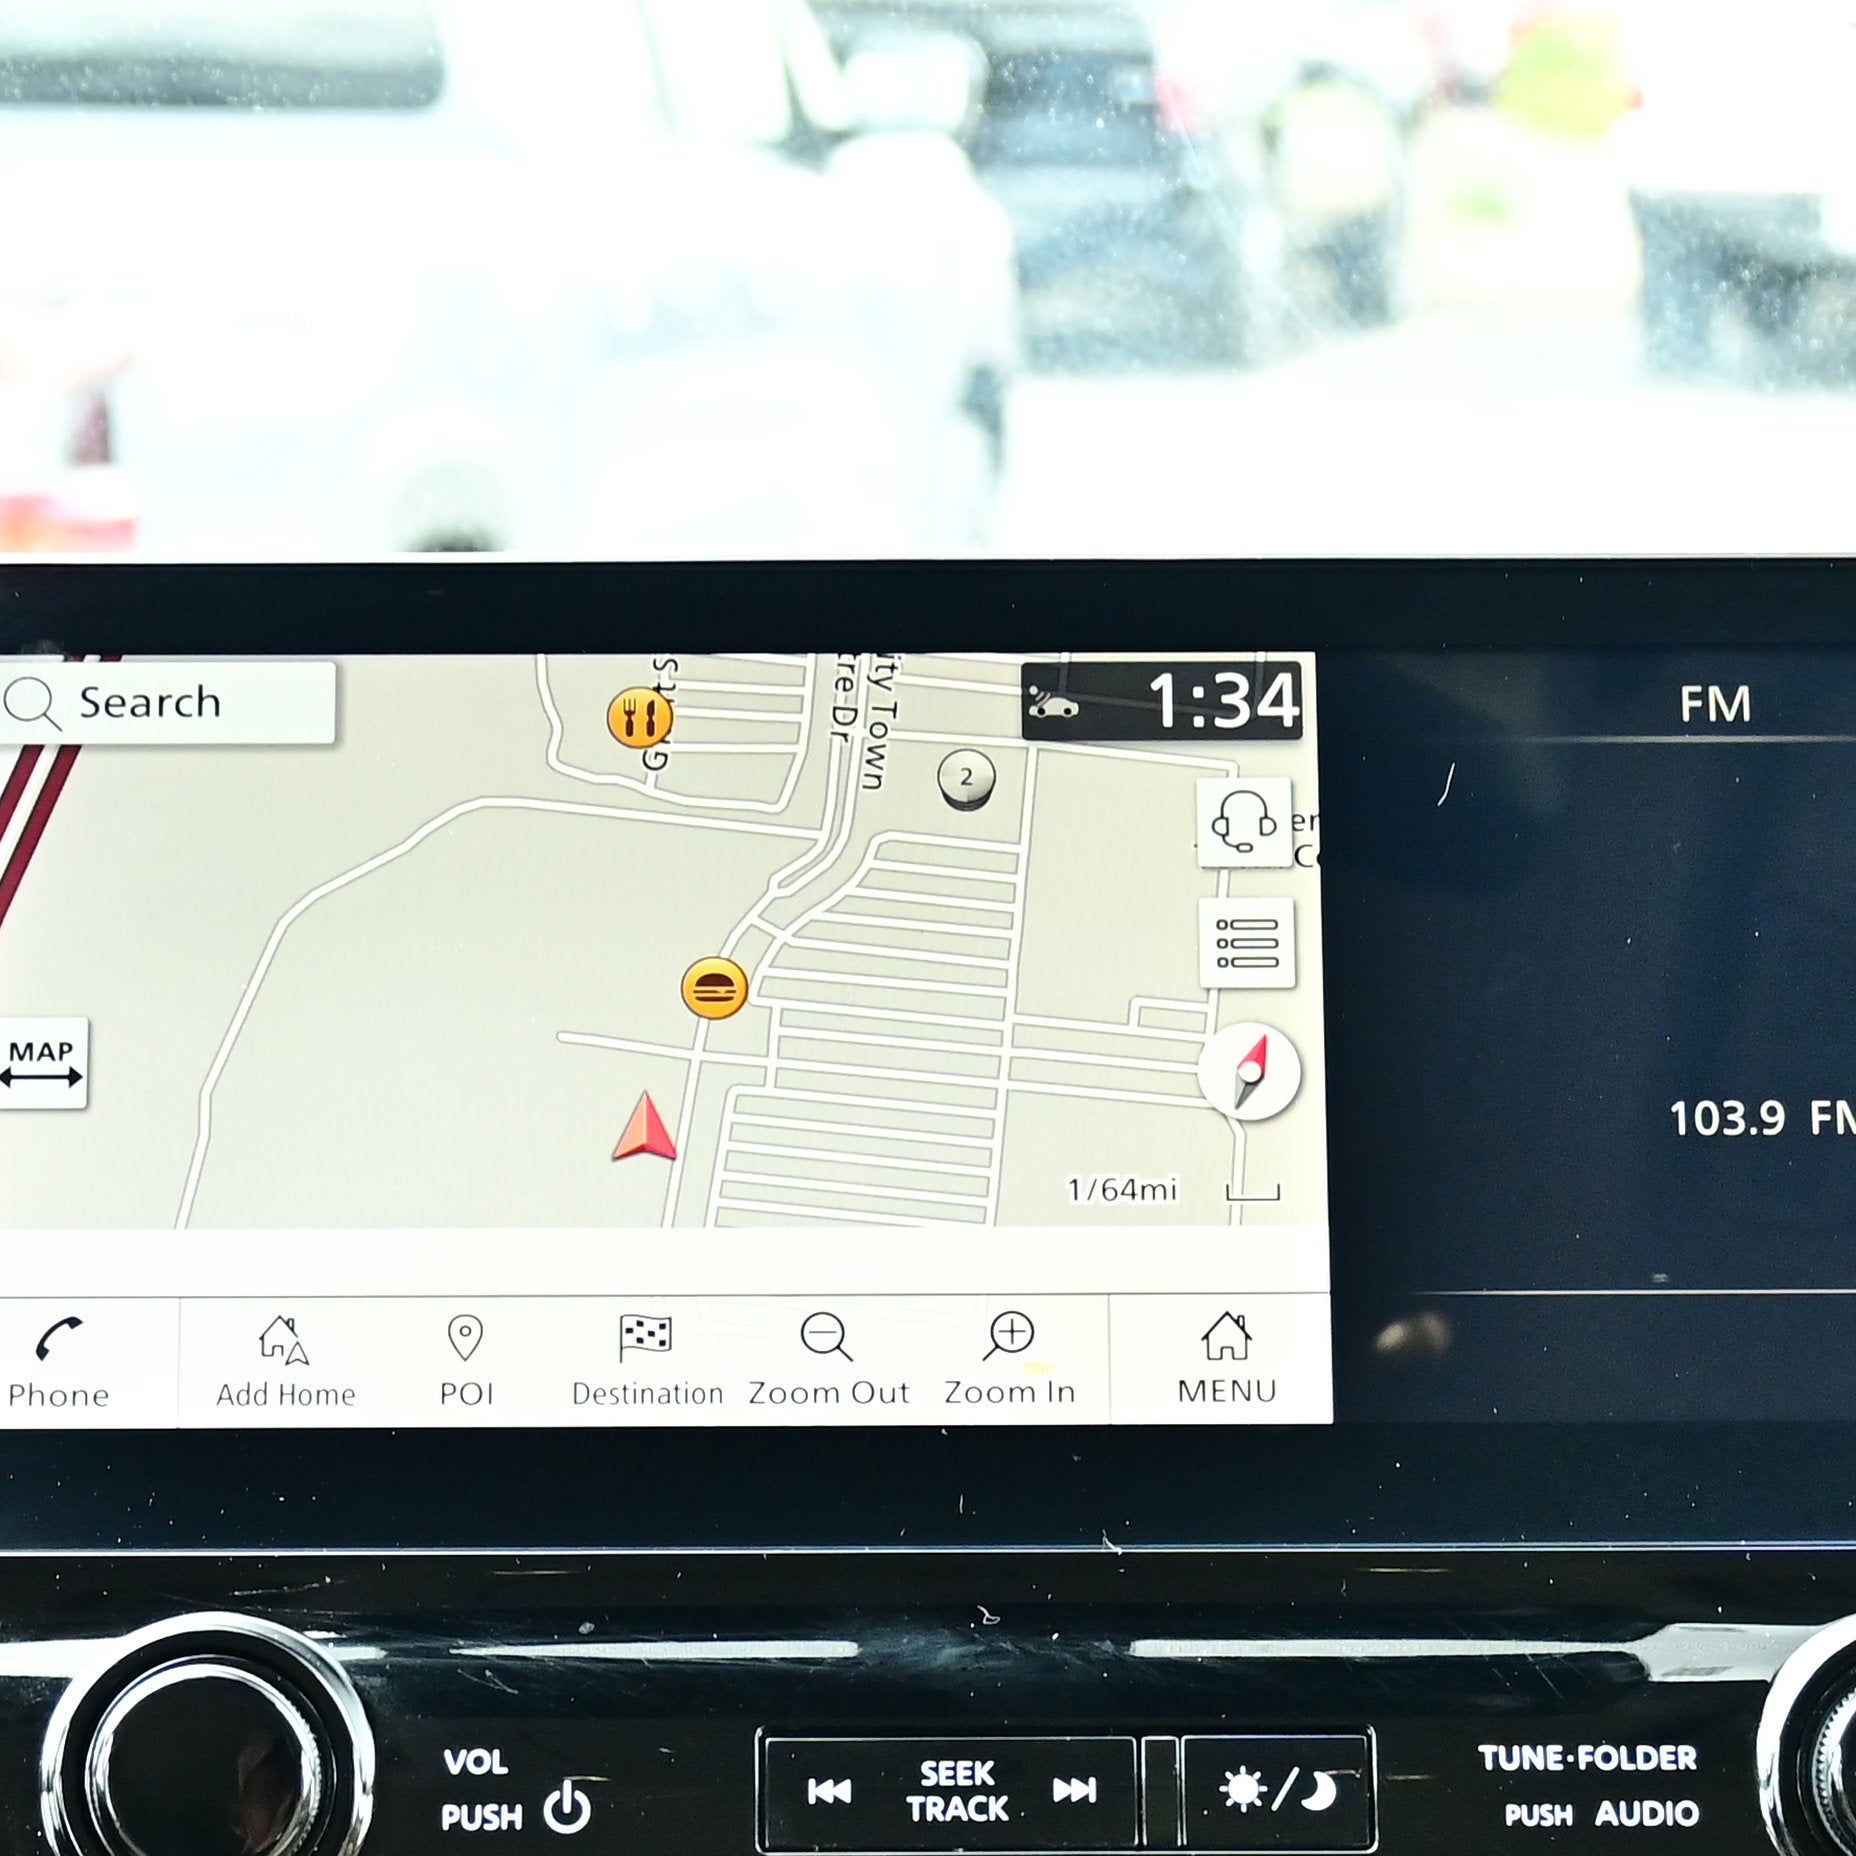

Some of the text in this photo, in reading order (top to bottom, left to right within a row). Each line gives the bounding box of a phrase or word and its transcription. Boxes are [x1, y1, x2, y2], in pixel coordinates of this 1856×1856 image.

[79, 684, 222, 720] Search
[1149, 671, 1301, 730] 1:34
[1680, 684, 1752, 723] FM
[829, 705, 859, 744] Dr
[861, 700, 898, 791] Town
[960, 767, 974, 787] 2
[8, 1041, 75, 1062] MAP
[1670, 1099, 1786, 1138] 103.9
[1067, 1175, 1179, 1202] 1/64mi
[8, 1383, 109, 1408] Phone
[216, 1382, 356, 1407] Add Home
[440, 1381, 494, 1406] POI
[573, 1380, 724, 1406] Destination
[749, 1380, 910, 1405] Zoom Out
[944, 1380, 1076, 1404] Zoom In
[1177, 1379, 1277, 1403] MENU
[444, 1748, 510, 1776] VOL
[919, 1759, 995, 1787] SEEK
[442, 1803, 523, 1831] PUSH
[906, 1795, 1010, 1823] TRACK
[1505, 1799, 1701, 1828] PUSH AUDIO
